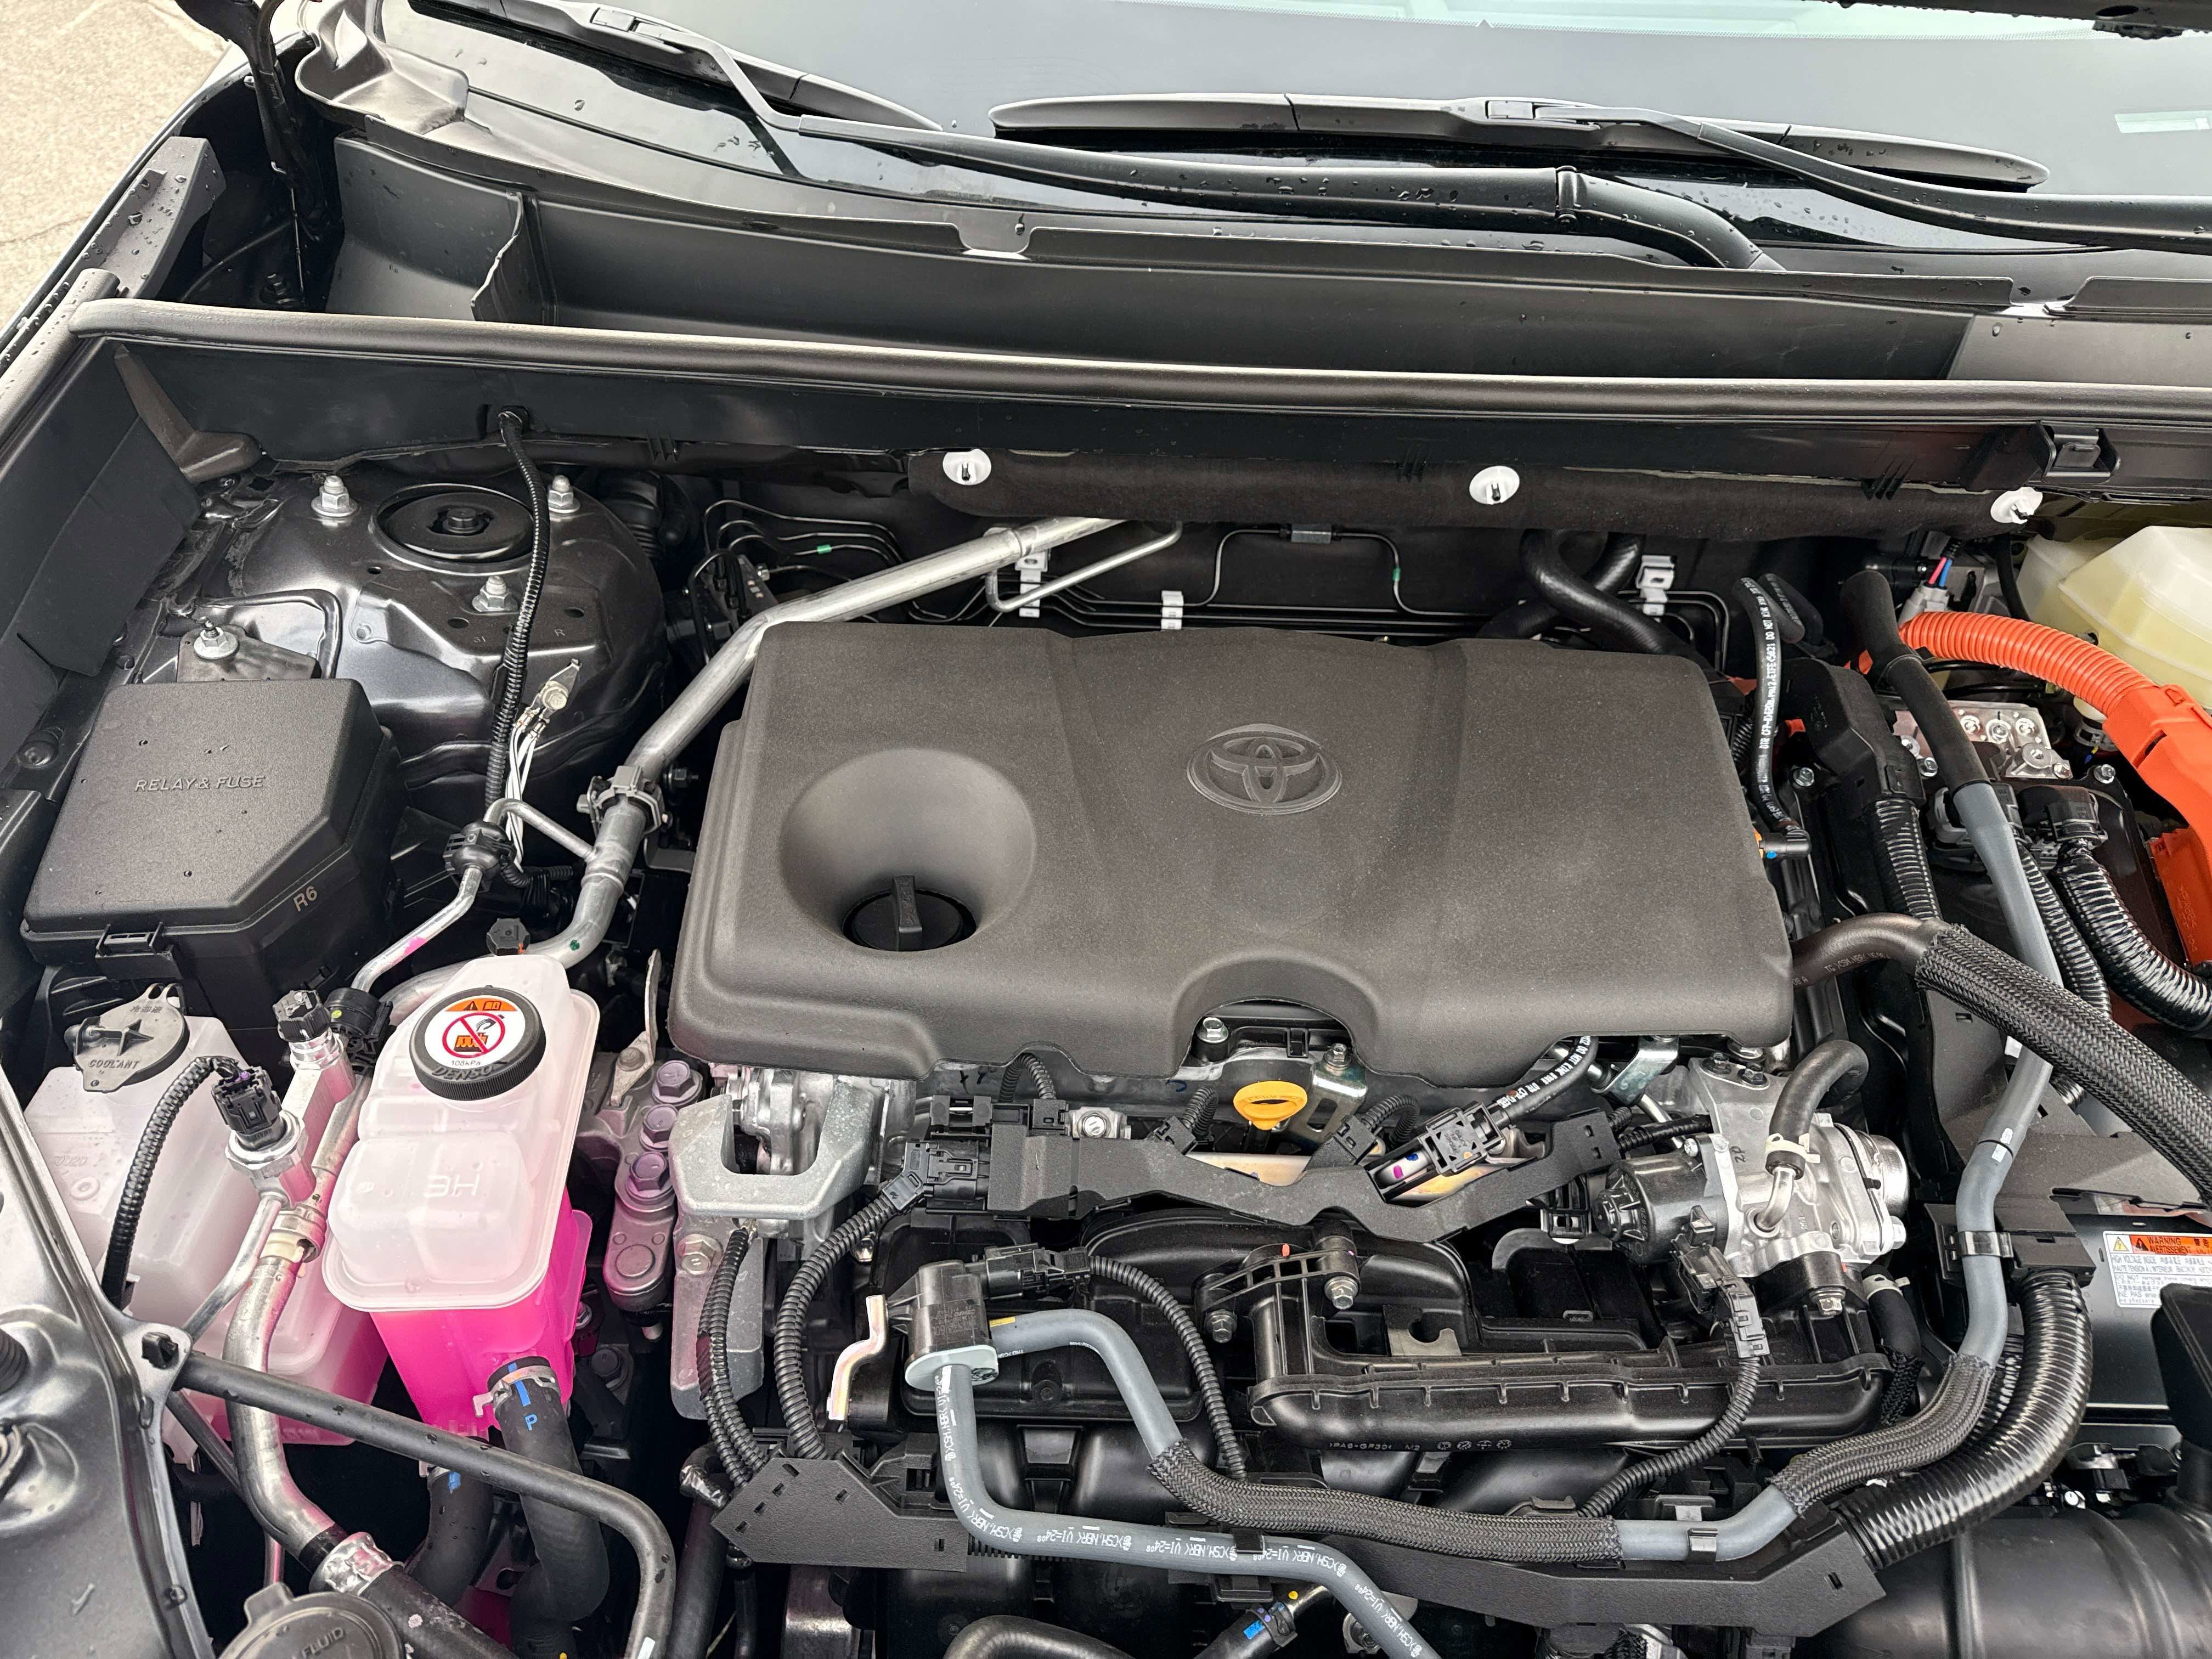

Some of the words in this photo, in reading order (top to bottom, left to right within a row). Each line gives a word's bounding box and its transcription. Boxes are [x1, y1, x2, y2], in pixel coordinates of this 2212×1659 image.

[135, 778, 195, 792] RELAY
[198, 777, 210, 789] &
[216, 775, 266, 789] FUSE
[293, 886, 318, 912] R6
[89, 1058, 140, 1069] COOLANT
[432, 1065, 492, 1080] DENSO
[2147, 1236, 2182, 1246] WARNING
[525, 1414, 538, 1431] P
[302, 1627, 345, 1659] FLUID
